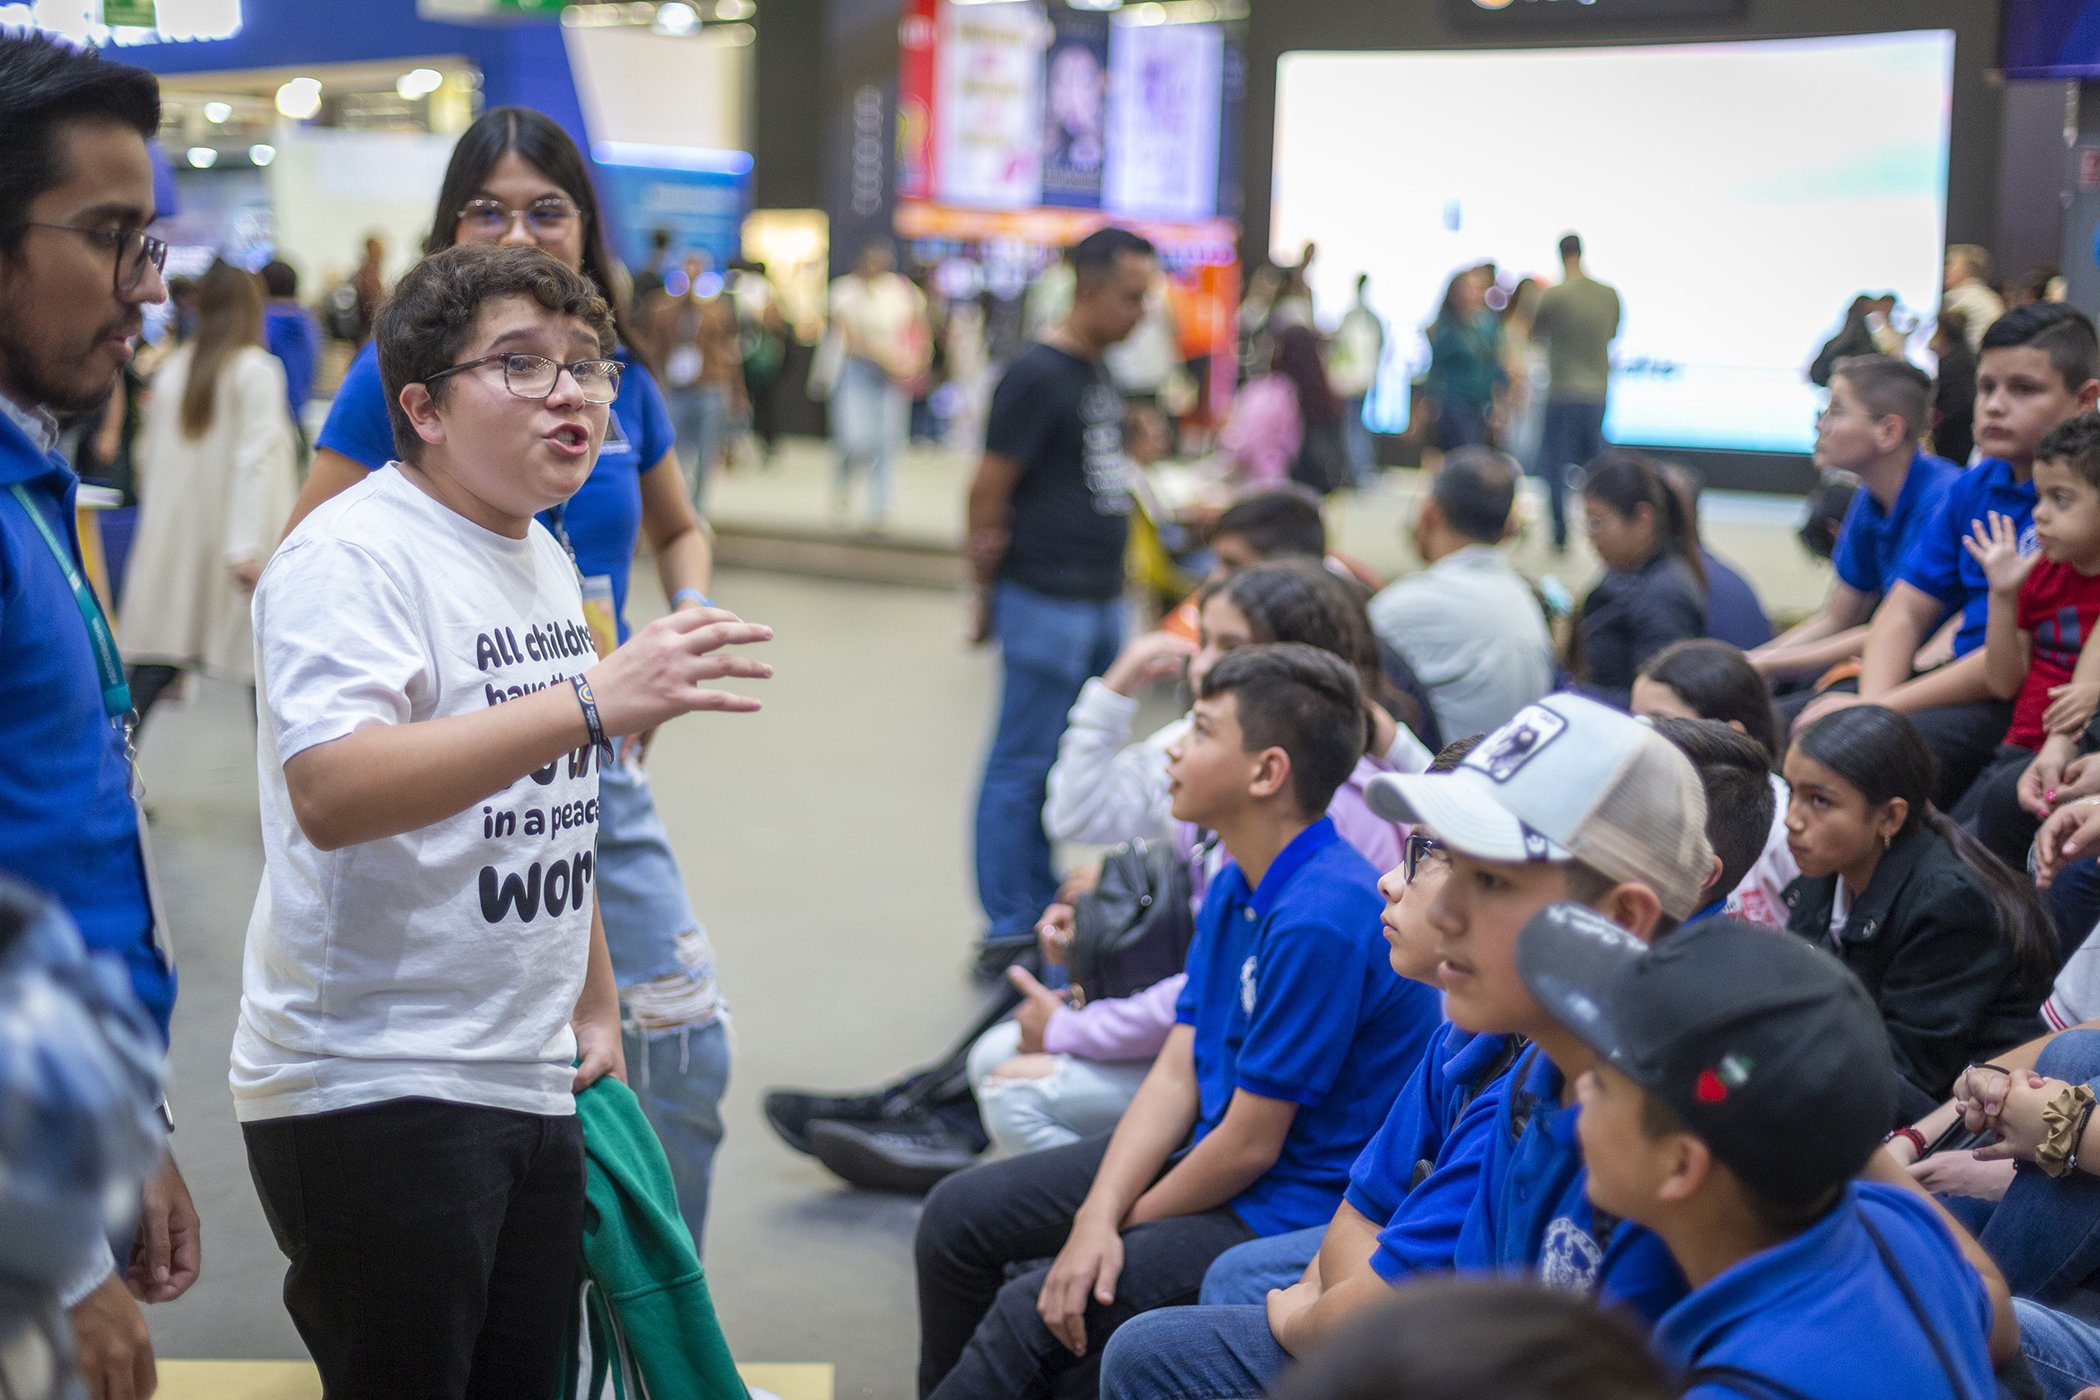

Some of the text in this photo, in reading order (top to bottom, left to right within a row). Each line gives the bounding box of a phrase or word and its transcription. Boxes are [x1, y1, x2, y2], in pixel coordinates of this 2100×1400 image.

[476, 626, 524, 671] All
[483, 805, 516, 839] in
[524, 808, 546, 836] a
[478, 847, 596, 924] wor
